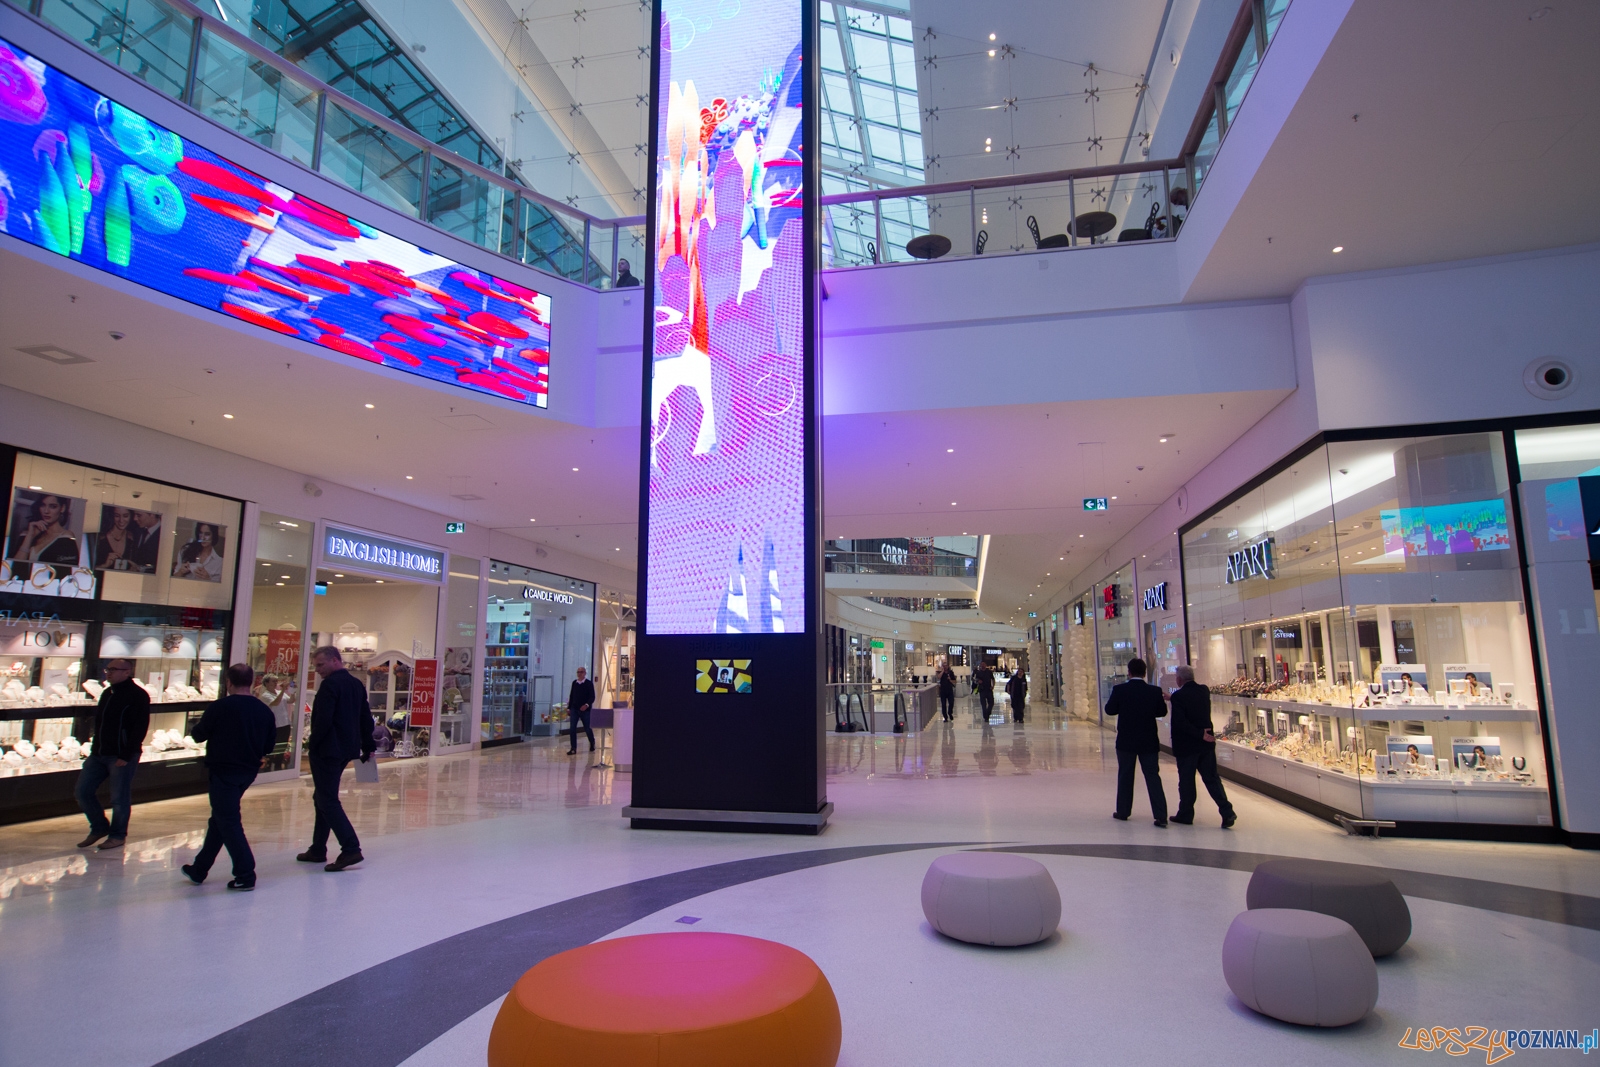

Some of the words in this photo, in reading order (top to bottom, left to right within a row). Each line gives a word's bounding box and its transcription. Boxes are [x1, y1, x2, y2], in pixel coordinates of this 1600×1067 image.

[329, 536, 398, 567] ENGLISH
[400, 551, 440, 575] HOME
[881, 543, 908, 565] CARRY
[1225, 538, 1269, 584] APART
[528, 588, 553, 602] CANDLE
[553, 593, 574, 605] WORLD
[1143, 582, 1165, 611] APART
[412, 690, 435, 704] 50%
